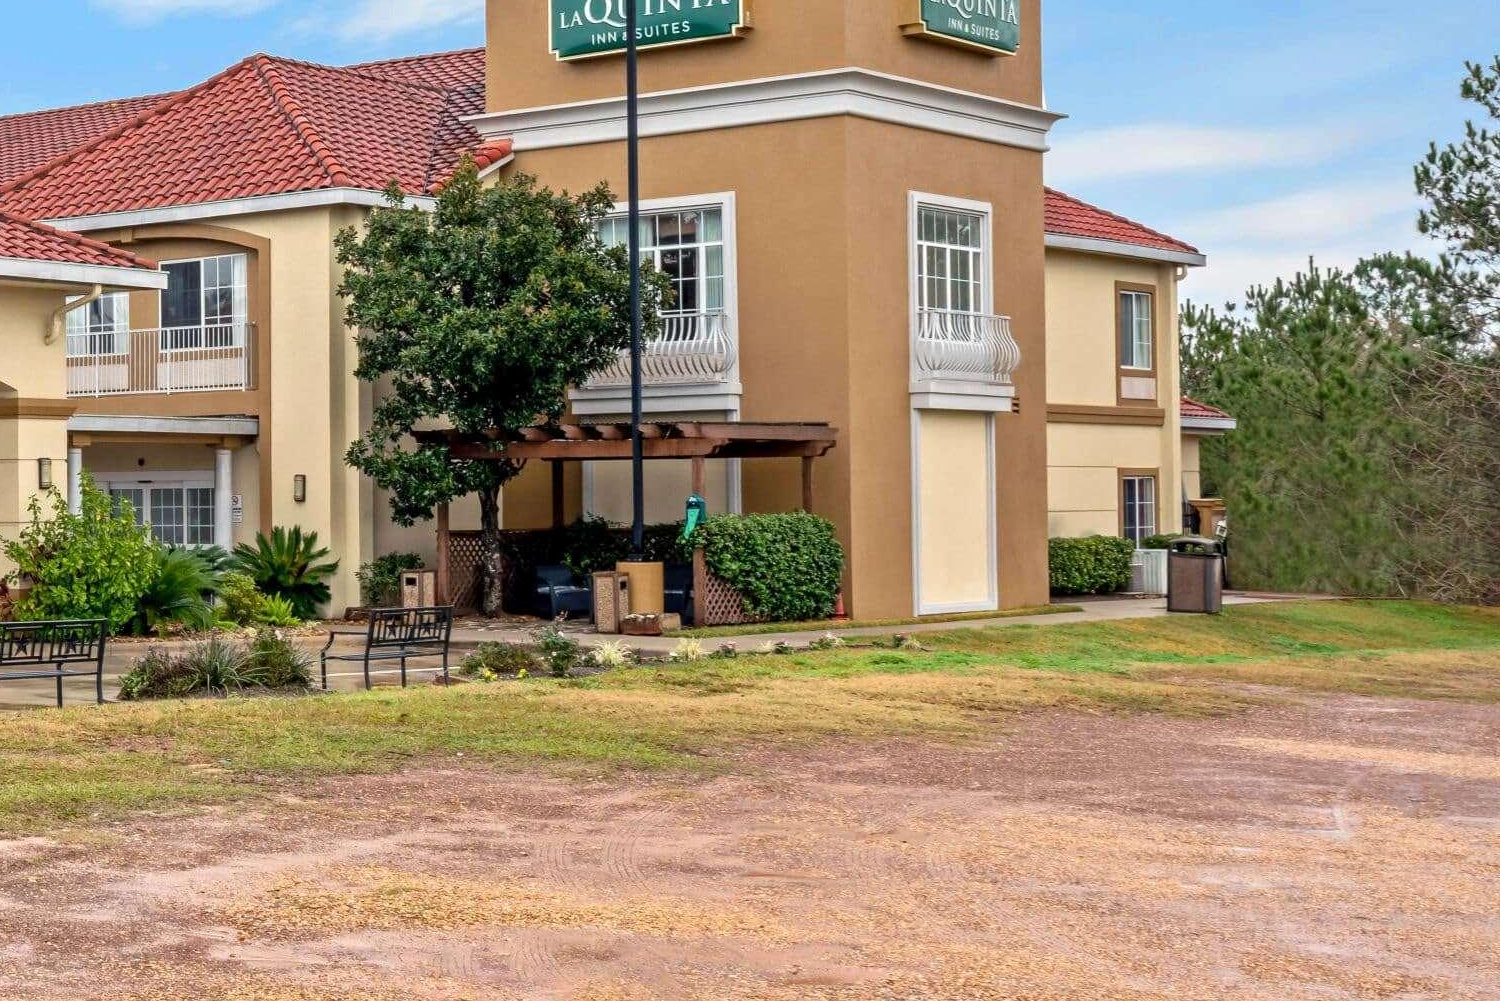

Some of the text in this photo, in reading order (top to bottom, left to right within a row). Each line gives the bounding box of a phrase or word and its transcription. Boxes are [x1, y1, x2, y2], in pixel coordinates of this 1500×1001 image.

[591, 31, 617, 46] INN
[635, 20, 690, 40] SUITES
[948, 17, 963, 31] INN
[971, 23, 999, 40] SUITES
